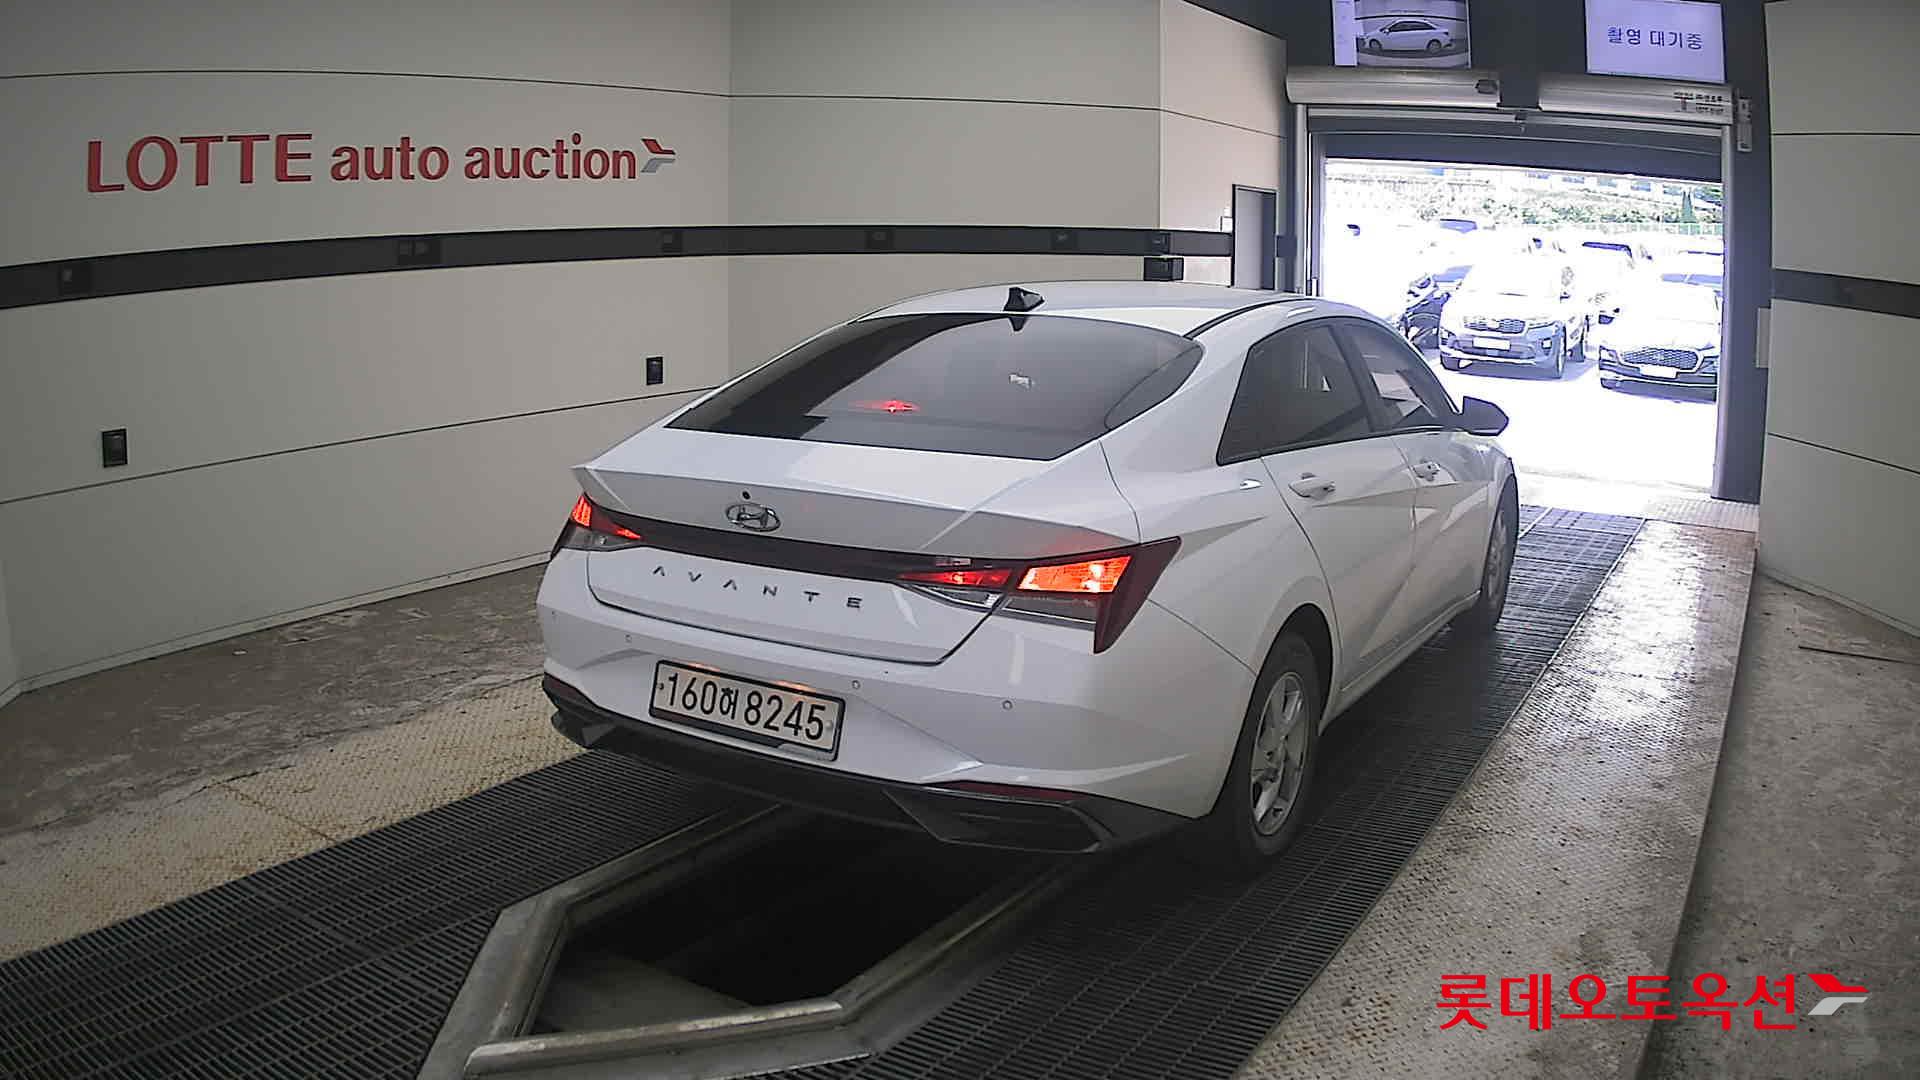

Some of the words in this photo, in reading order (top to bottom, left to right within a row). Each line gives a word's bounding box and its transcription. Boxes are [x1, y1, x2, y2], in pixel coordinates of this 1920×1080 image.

[1607, 26, 1641, 45] 촬영
[1649, 30, 1703, 50] 대기중
[87, 133, 313, 193] LOTTE
[330, 136, 450, 182] auto
[464, 132, 638, 181] auction
[652, 564, 863, 610] AVANTE
